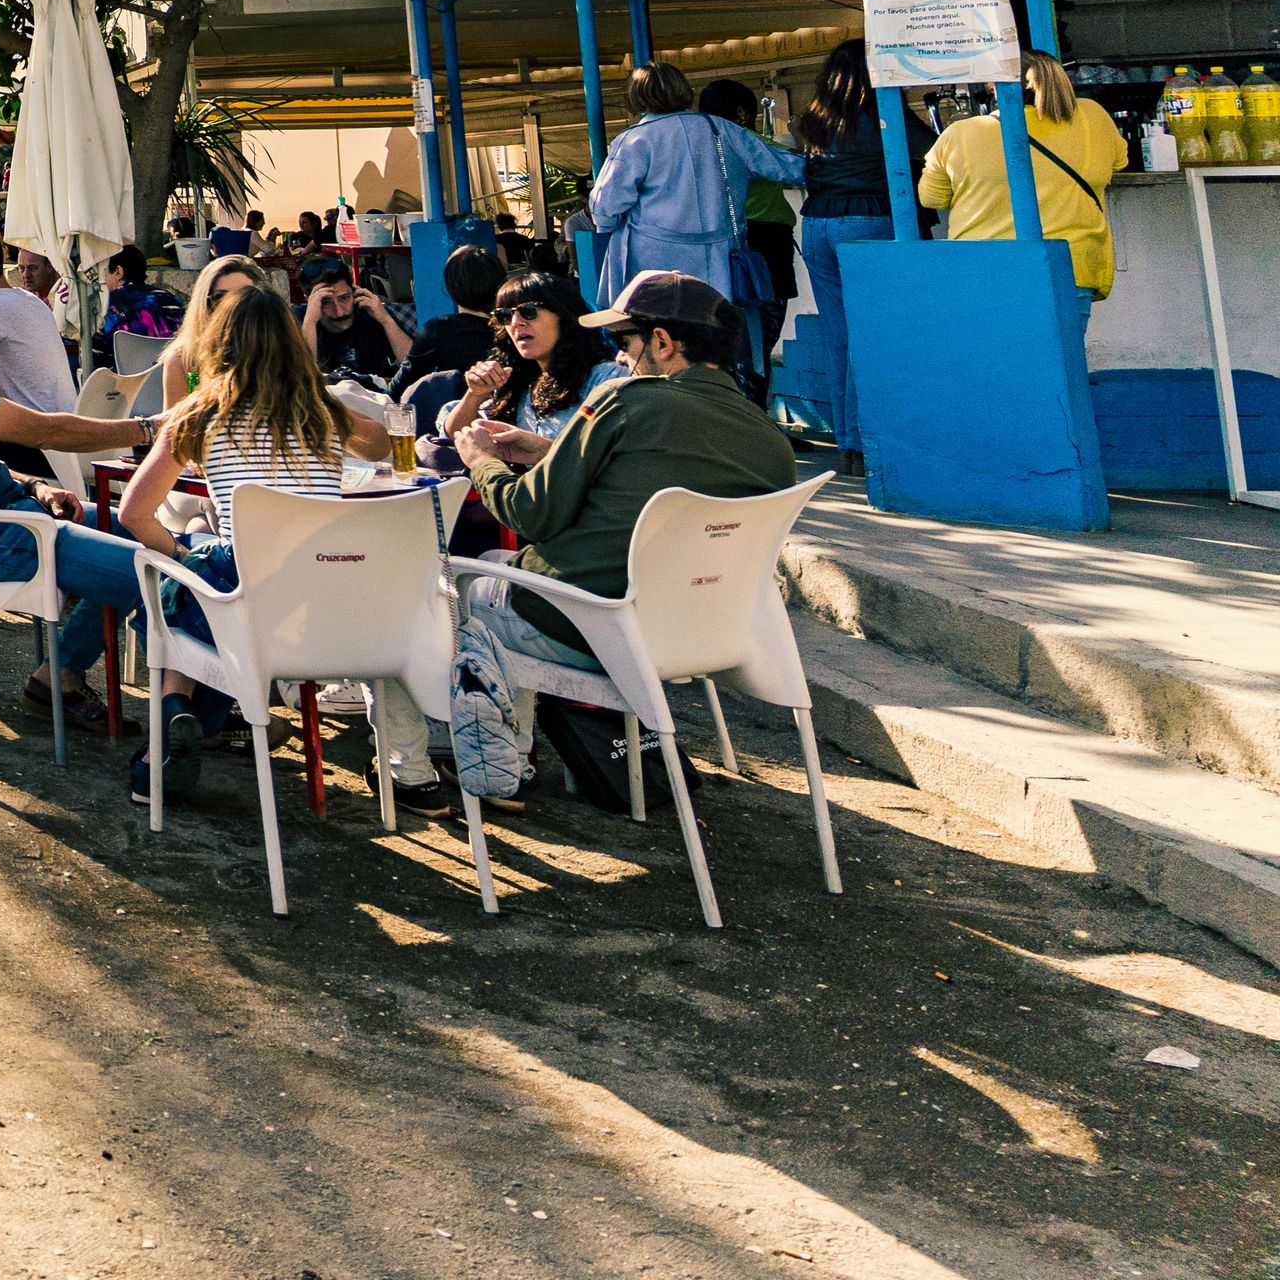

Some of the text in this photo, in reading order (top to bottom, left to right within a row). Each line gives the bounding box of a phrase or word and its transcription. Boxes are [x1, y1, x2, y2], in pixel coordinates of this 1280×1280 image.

[927, 4, 958, 12] solicitar
[944, 37, 974, 46] request
[704, 522, 742, 532] Cruzcampo
[316, 553, 366, 563] Cruzcampo
